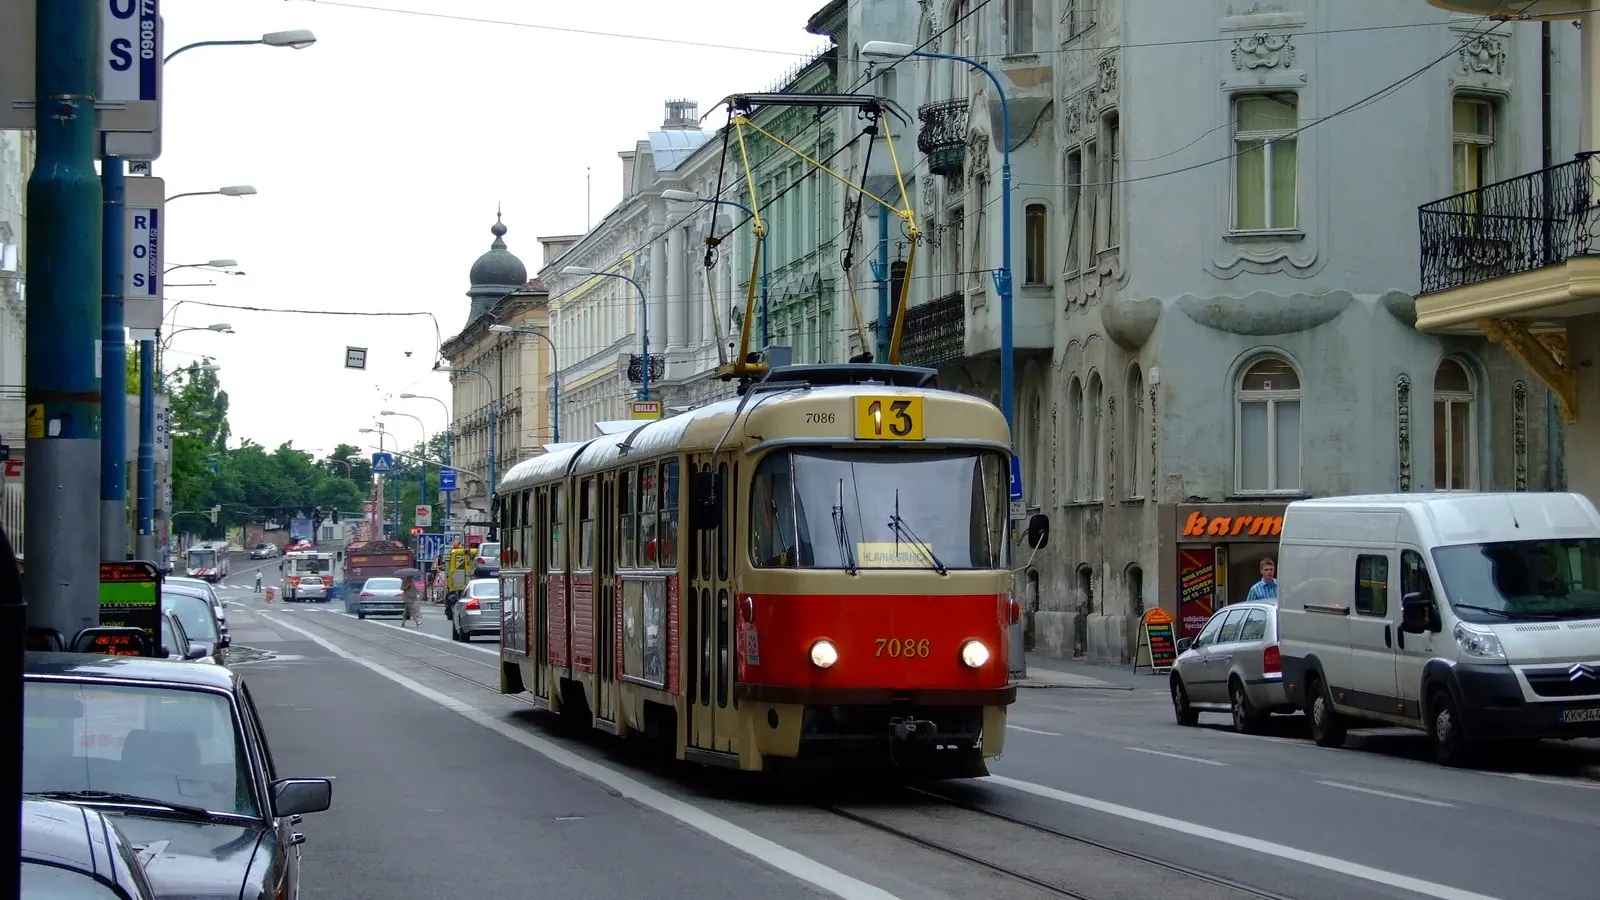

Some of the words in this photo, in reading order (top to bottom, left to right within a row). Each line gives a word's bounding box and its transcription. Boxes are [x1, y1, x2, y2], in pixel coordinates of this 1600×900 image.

[141, 20, 154, 60] 0908
[805, 412, 836, 424] 7086
[868, 400, 913, 436] 13
[1183, 511, 1282, 536] karm
[874, 638, 930, 658] 7086
